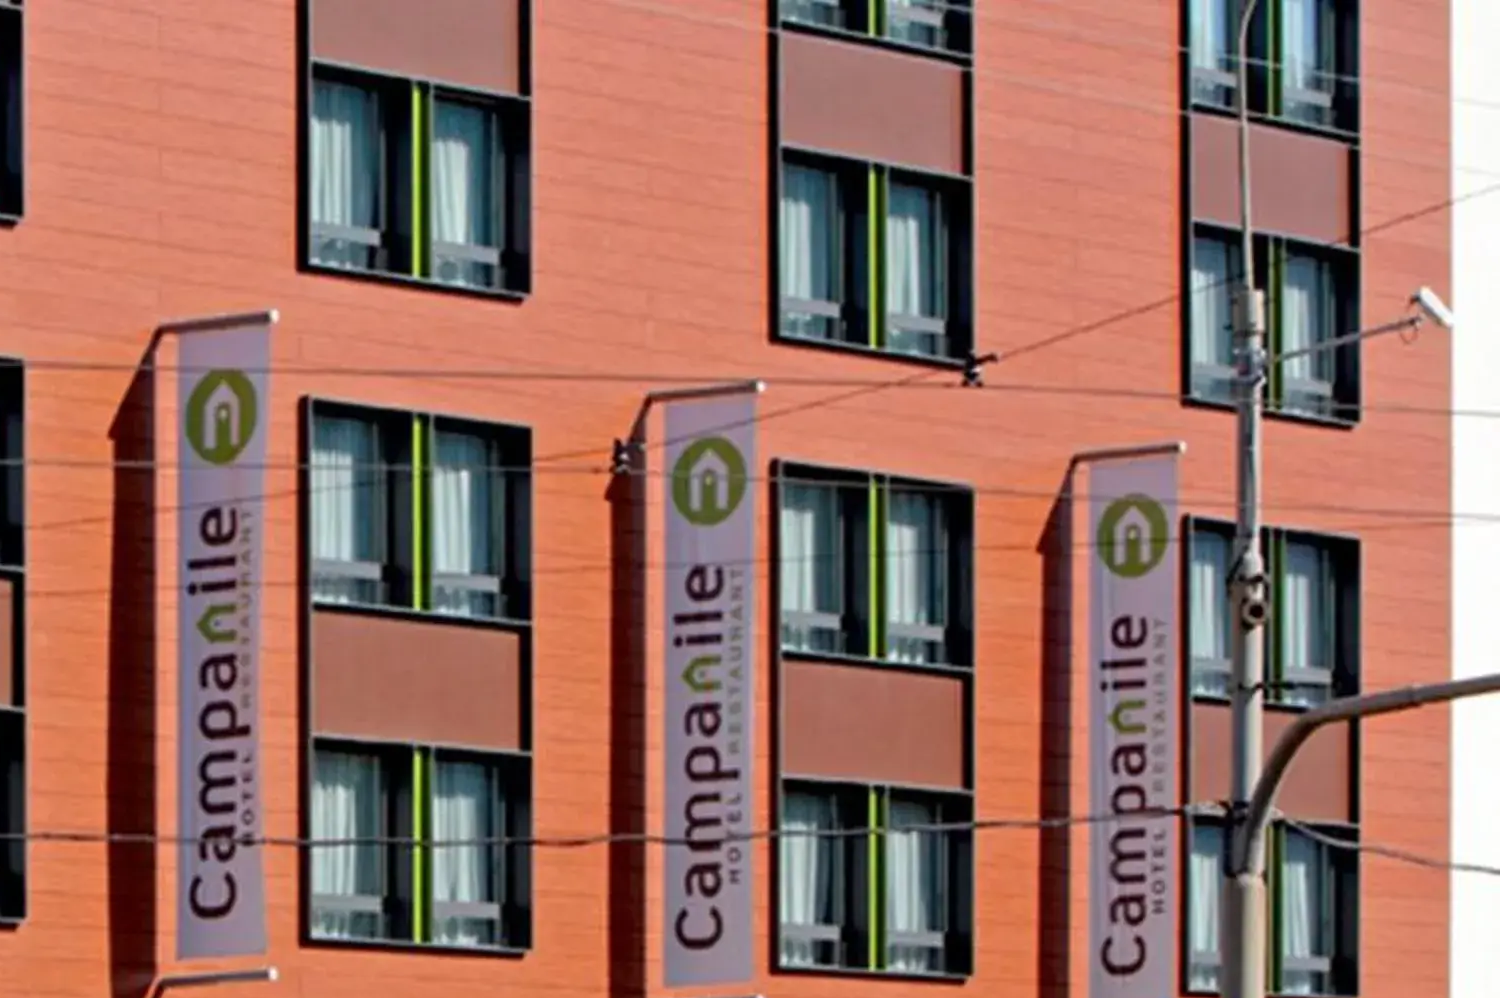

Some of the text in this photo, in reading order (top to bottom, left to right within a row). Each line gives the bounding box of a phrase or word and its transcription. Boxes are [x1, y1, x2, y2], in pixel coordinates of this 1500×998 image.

[187, 506, 251, 921] Campanile
[240, 508, 255, 847] HOTEL RESTAURANT
[674, 563, 739, 950] Campanile
[727, 568, 744, 885] HOTEL RESTAURANT
[1100, 614, 1160, 976] Campanile
[1152, 617, 1168, 915] HOTEL RESTAURANT
